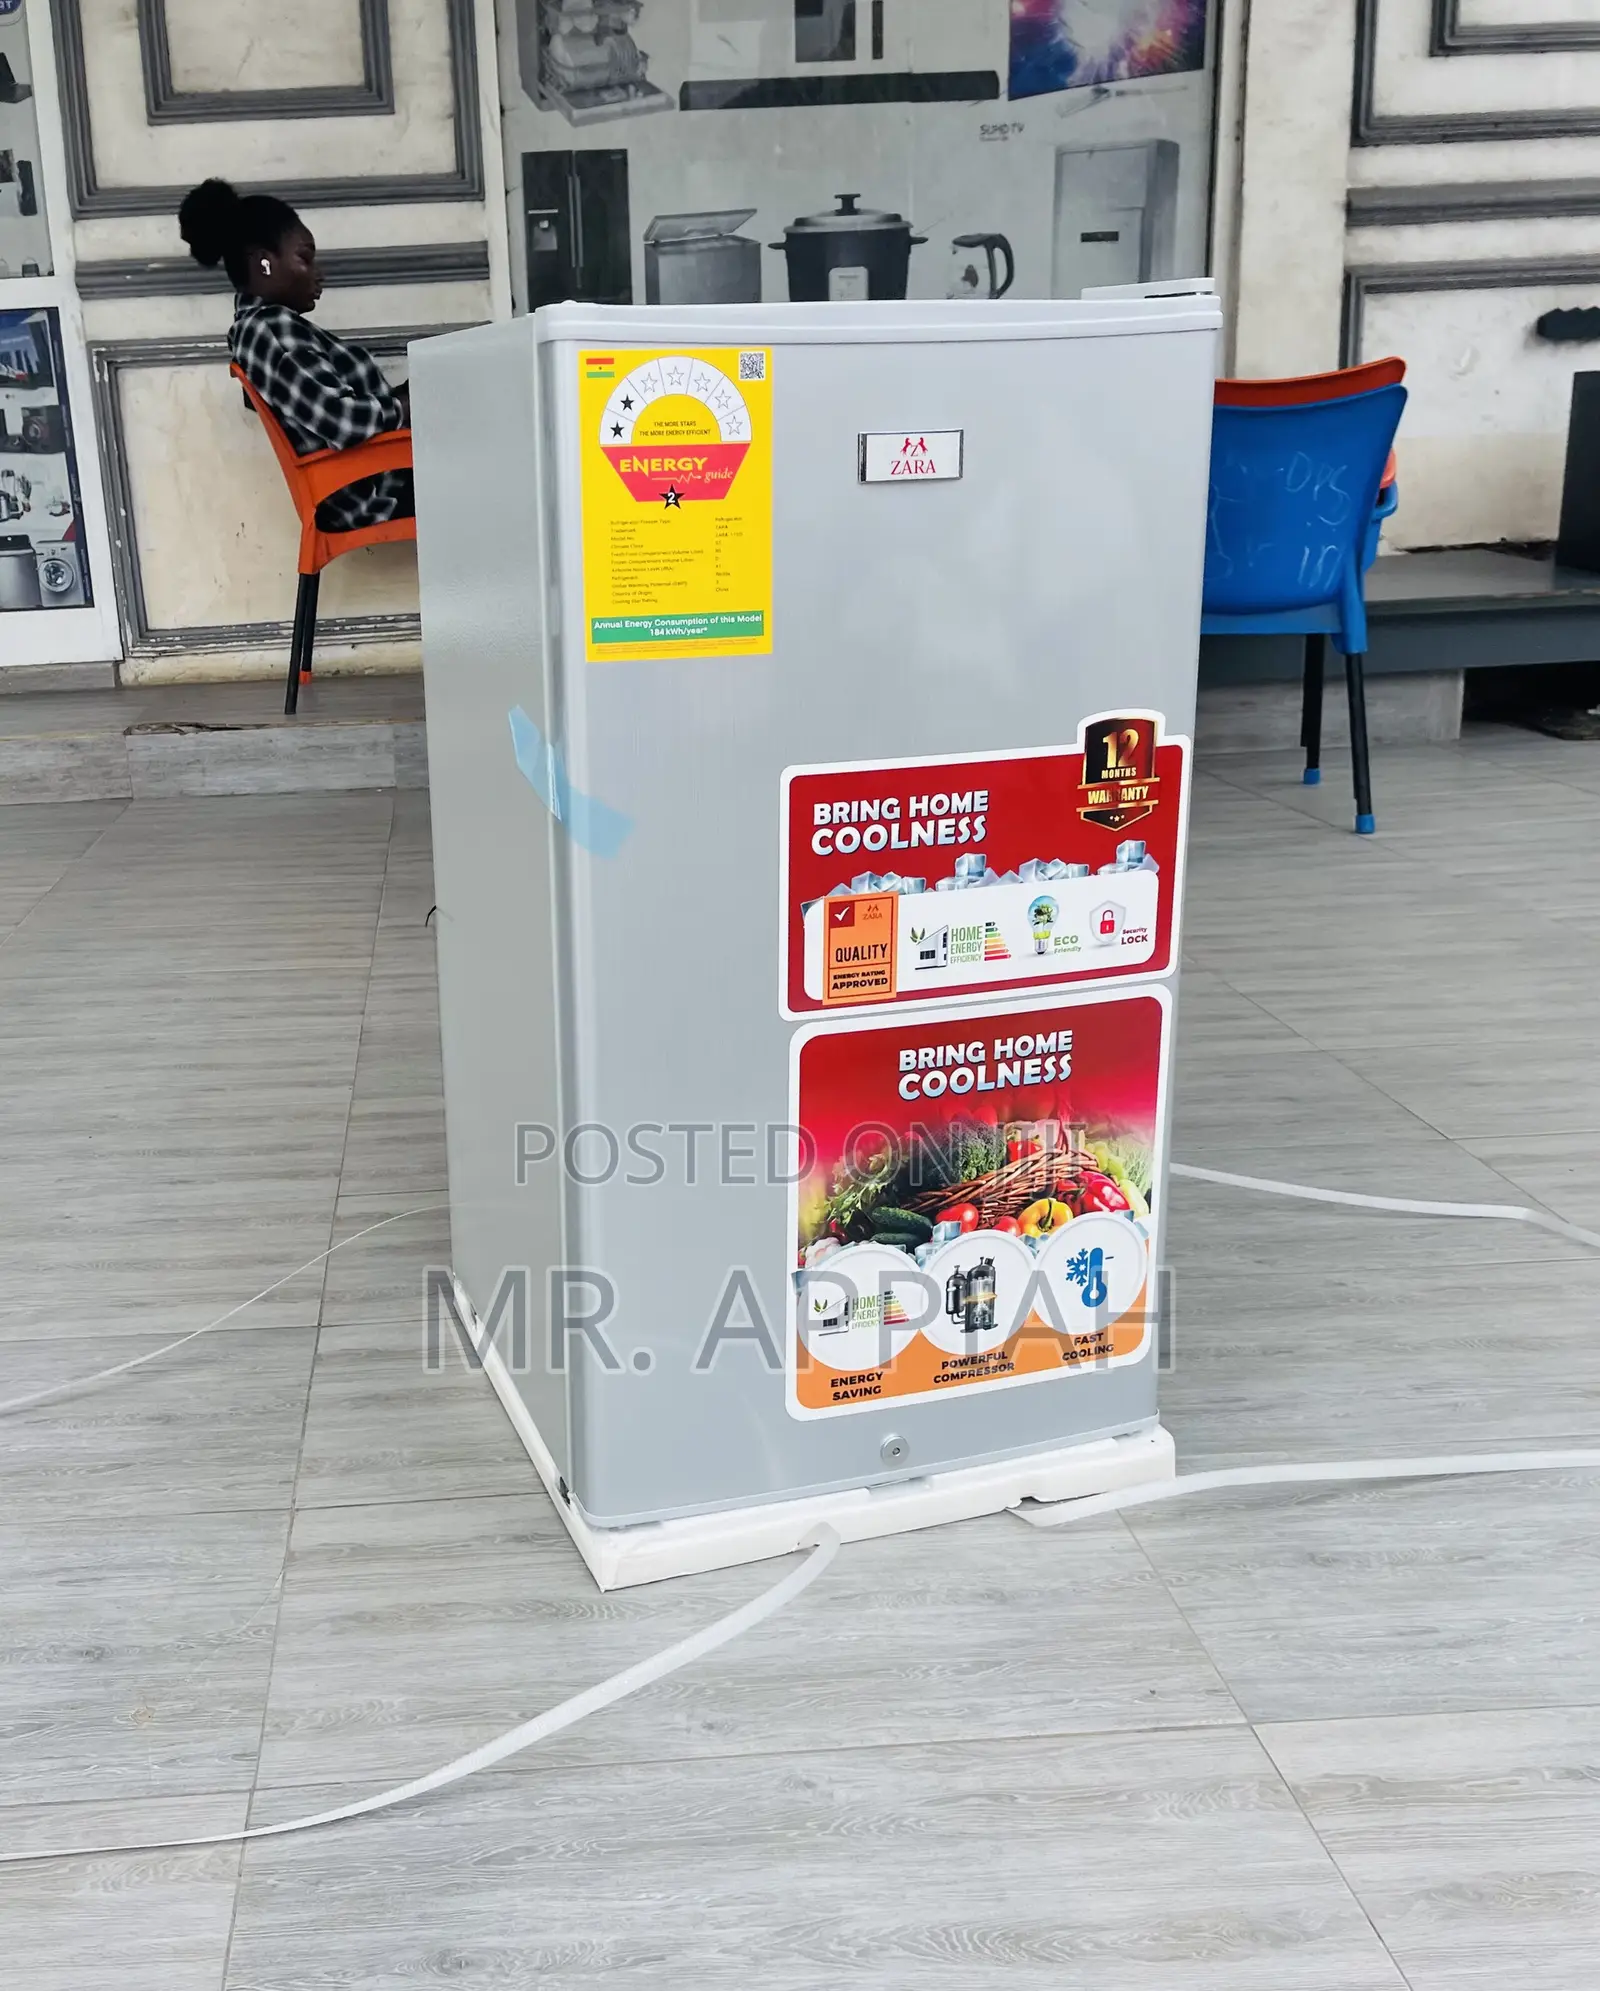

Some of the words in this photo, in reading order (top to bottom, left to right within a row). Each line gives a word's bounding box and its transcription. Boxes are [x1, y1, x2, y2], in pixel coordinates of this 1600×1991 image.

[1011, 122, 1025, 133] TV
[686, 428, 711, 436] EFFICIENT
[620, 455, 708, 477] ENERGY
[891, 459, 936, 475] ZARA
[704, 466, 734, 484] guide
[667, 491, 676, 503] 2
[594, 620, 623, 629] Annual
[625, 619, 653, 629] Energy
[654, 616, 708, 627] Consumption
[710, 615, 719, 624] of
[720, 615, 735, 623] this
[737, 614, 762, 622] Model
[1103, 728, 1139, 769] 12
[1101, 767, 1137, 779] MONTHS
[813, 797, 901, 826] BRING
[909, 790, 989, 818] HOME
[811, 815, 987, 856] COOLNESS
[862, 912, 883, 921] ZARA
[951, 925, 983, 942] HOME
[1122, 926, 1148, 935] Security
[1053, 934, 1079, 947] ECO
[1121, 934, 1149, 946] LOCK
[835, 943, 888, 963] QUALITY
[950, 941, 983, 955] ENERGY
[1053, 945, 1082, 955] Friendly
[950, 953, 982, 965] EFFICIENCY
[833, 972, 860, 980] ENERGY
[861, 969, 886, 978] RATING
[832, 977, 889, 991] APPROVED
[899, 1041, 986, 1073] BRING
[993, 1030, 1073, 1061] HOME
[898, 1053, 1073, 1101] COOLNESS
[852, 1294, 882, 1311] HOME
[852, 1307, 882, 1321] ENERGY
[1074, 1333, 1104, 1346] FAST
[941, 1350, 1009, 1370] POWERFUL
[1062, 1344, 1115, 1361] COOLING
[830, 1371, 884, 1388] ENERGY
[933, 1362, 1015, 1384] COMPRESSOR
[832, 1385, 882, 1401] SAVING
